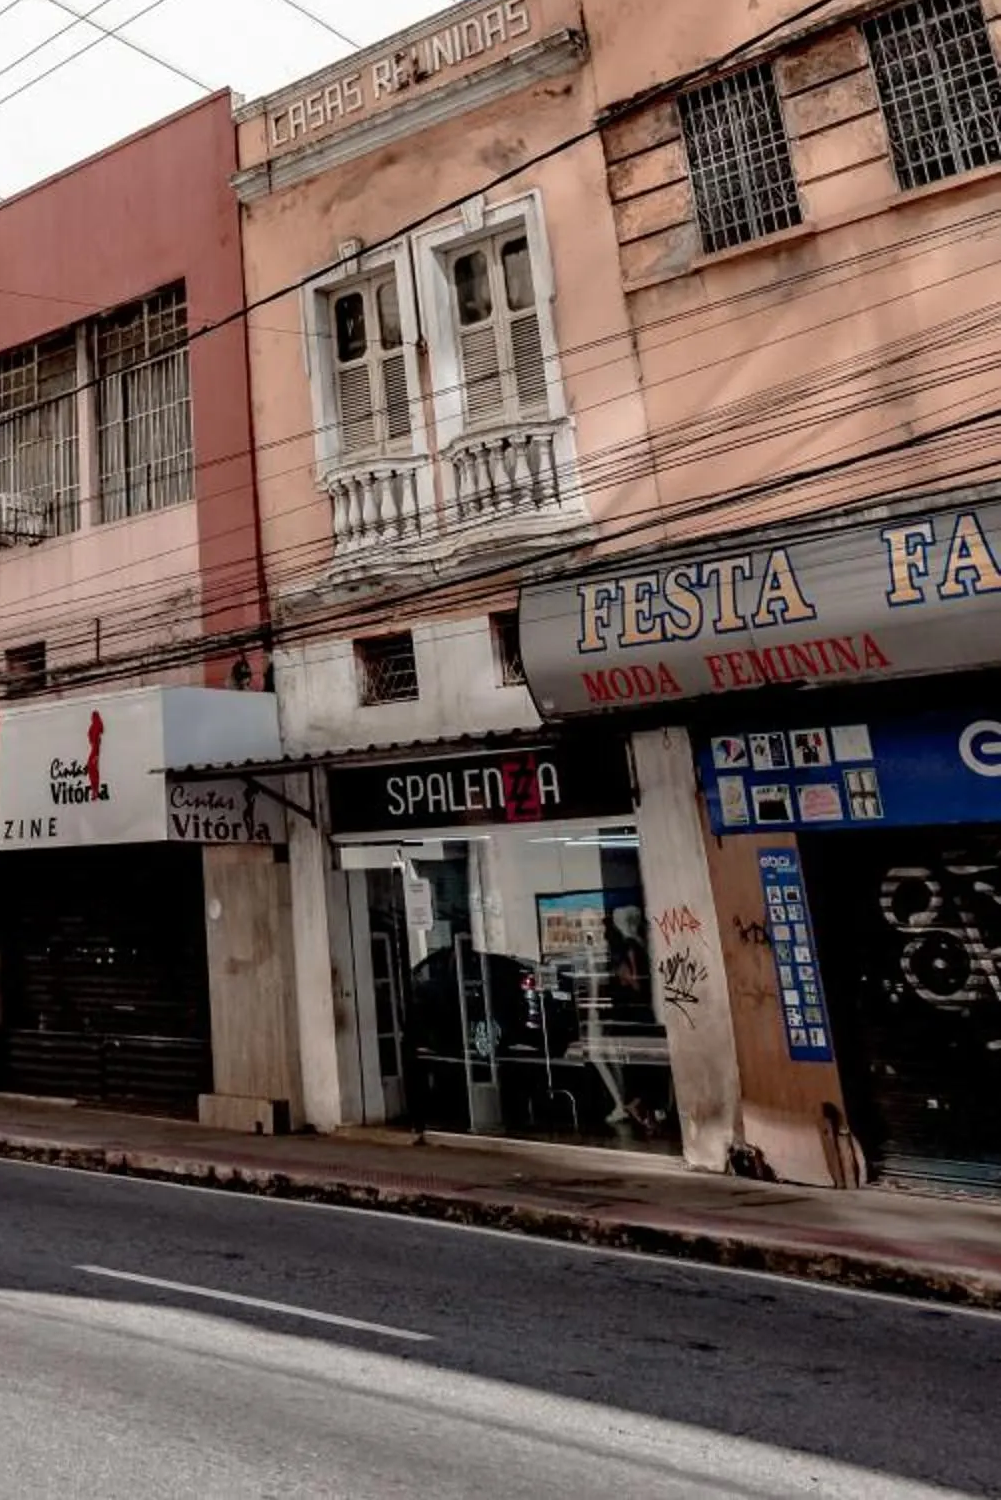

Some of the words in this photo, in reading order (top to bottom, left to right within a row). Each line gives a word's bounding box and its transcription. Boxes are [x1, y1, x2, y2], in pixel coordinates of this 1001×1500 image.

[270, 72, 364, 148] CASAS
[576, 547, 817, 654] FESTA
[581, 661, 683, 702] MODA
[704, 632, 892, 690] FEMININA
[50, 758, 89, 780] Cintas
[170, 785, 235, 811] Cintas
